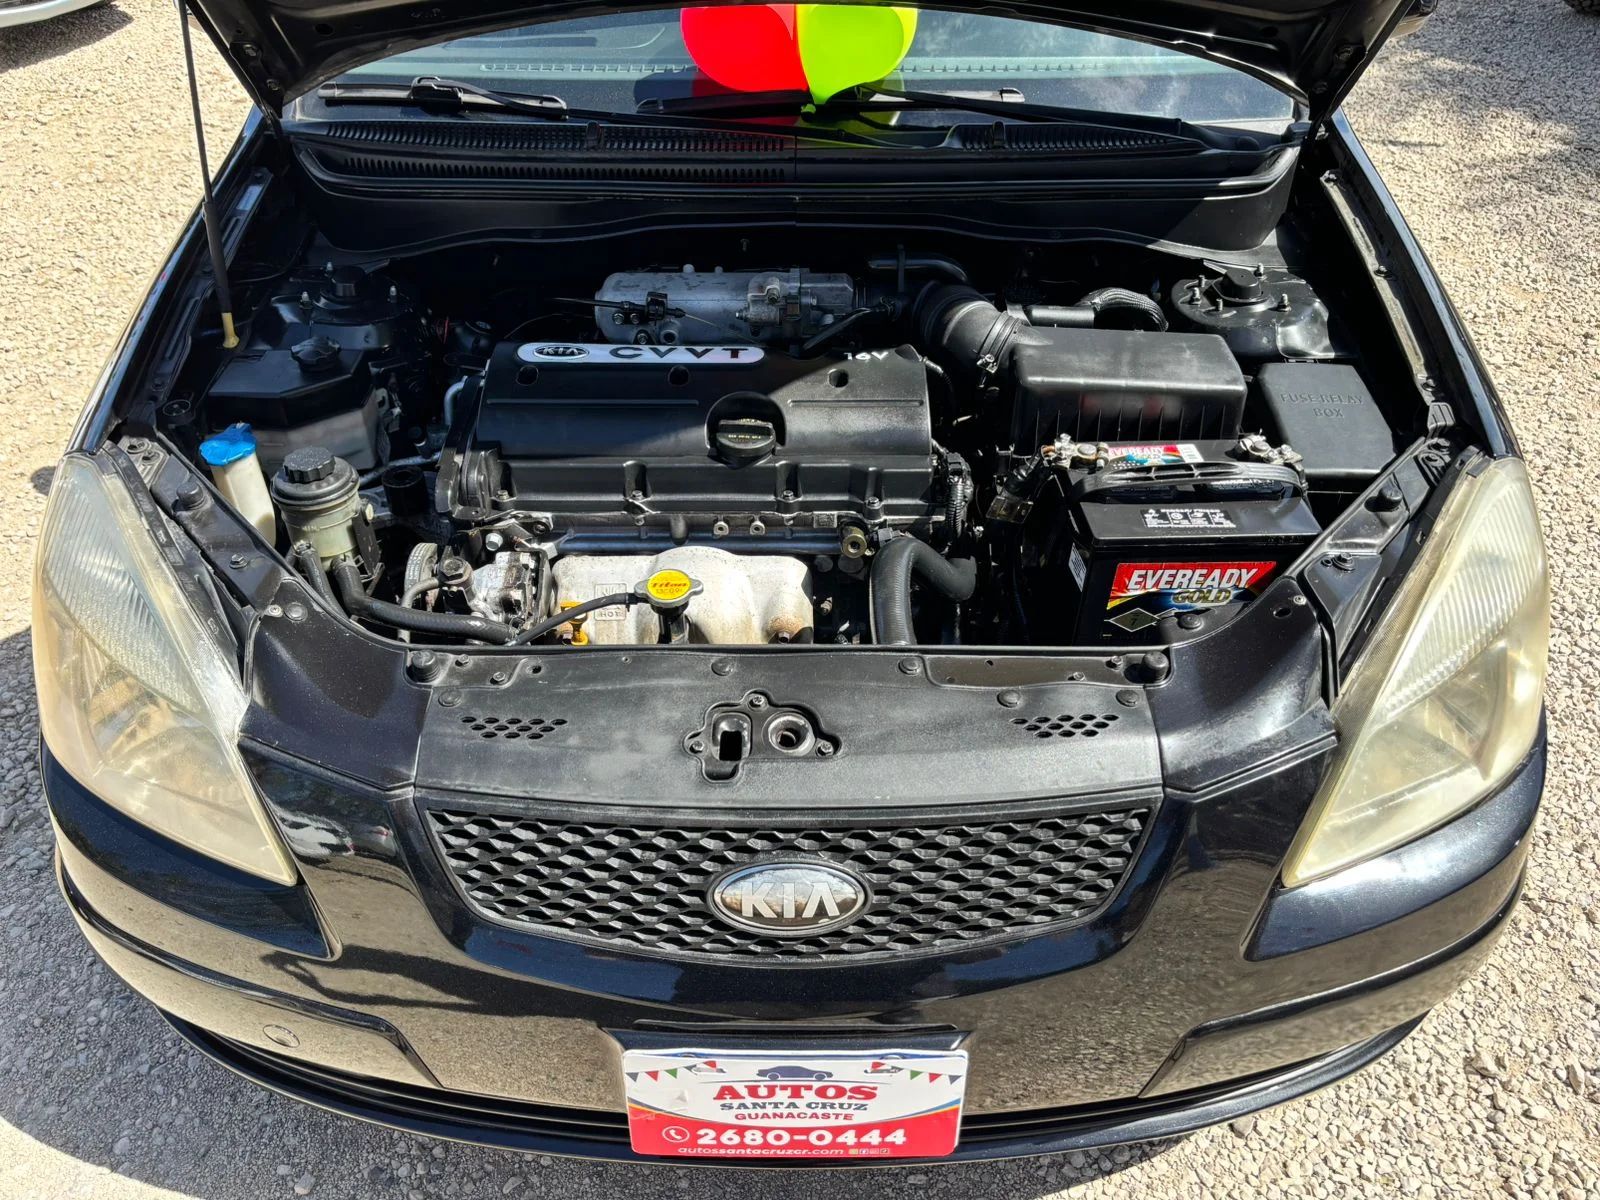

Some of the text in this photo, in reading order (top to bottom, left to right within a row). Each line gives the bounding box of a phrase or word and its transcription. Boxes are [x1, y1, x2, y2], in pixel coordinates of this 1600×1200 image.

[542, 346, 748, 359] KIA CVVT
[843, 351, 889, 361] 16V
[1280, 393, 1363, 404] FUSE RELAY
[1313, 407, 1344, 418] BOX
[1127, 568, 1258, 590] EVEREADY
[1173, 589, 1232, 604] GOLD
[741, 882, 840, 918] KIA
[713, 1085, 878, 1100] AUTOS
[720, 1102, 868, 1111] SANTA CRUZ
[734, 1112, 854, 1121] GUANACASTE
[696, 1128, 907, 1145] 2680-0444
[678, 1147, 844, 1155] autossantacruzcr.com
